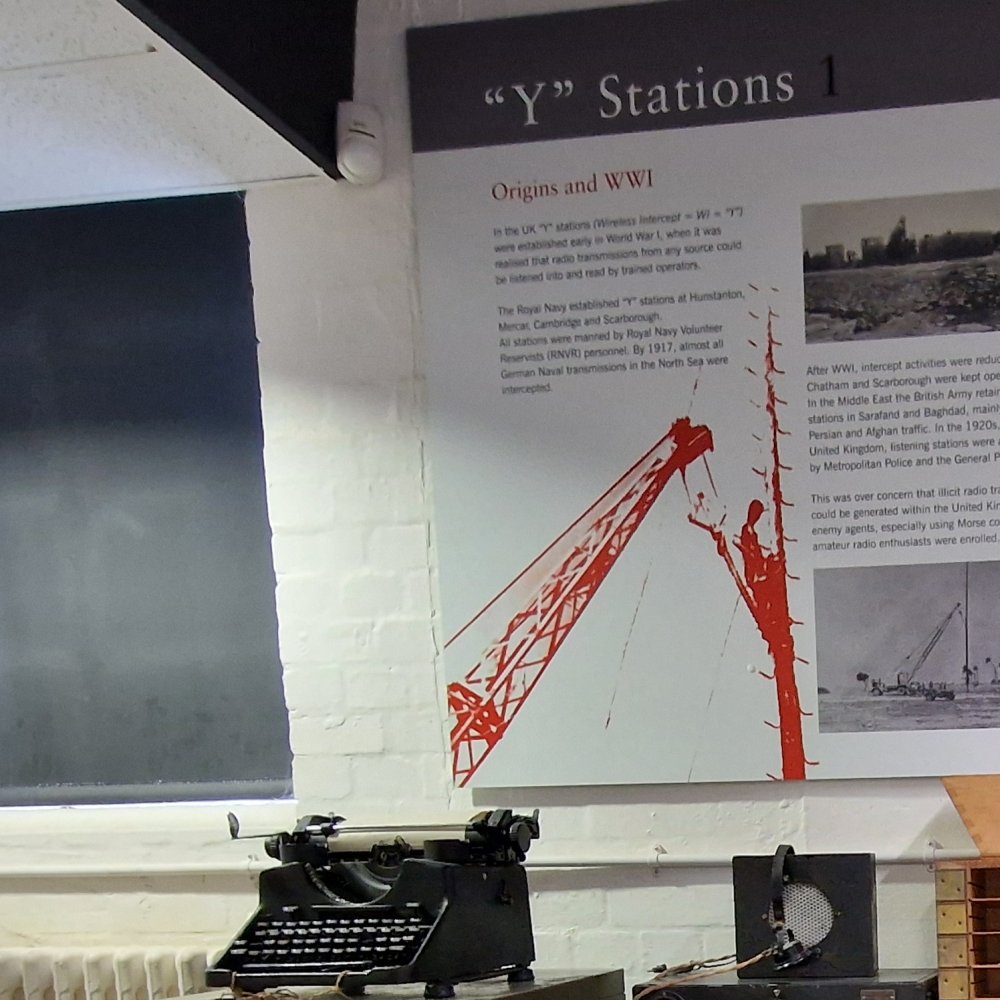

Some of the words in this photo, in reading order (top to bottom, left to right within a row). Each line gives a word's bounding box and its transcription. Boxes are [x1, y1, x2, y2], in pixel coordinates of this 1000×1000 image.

[484, 79, 574, 126] “Y”
[599, 66, 795, 119] Stations
[820, 53, 839, 97] 1
[491, 179, 559, 203] Origins
[564, 173, 598, 195] and
[604, 168, 653, 192] WWI
[493, 227, 502, 236] In
[505, 226, 519, 236] the
[522, 224, 536, 235] UK
[556, 221, 591, 232] stations
[593, 217, 636, 229] (Wireless
[639, 212, 681, 225] Intercept
[494, 244, 515, 252] were
[518, 240, 567, 251] established
[570, 239, 592, 248] early
[606, 232, 633, 243] World
[636, 231, 654, 241] War
[665, 228, 691, 239] when
[694, 227, 700, 237] it
[703, 226, 722, 236] was
[532, 256, 549, 265] that
[552, 255, 575, 264] radio
[577, 250, 638, 262] transmissions
[641, 247, 662, 256] from
[665, 247, 681, 256] any
[684, 244, 714, 253] source
[717, 240, 742, 251] could
[546, 270, 563, 281] into
[566, 269, 583, 279] and
[585, 267, 605, 278] read
[608, 266, 618, 277] by
[621, 264, 653, 275] trained
[499, 306, 514, 316] The
[517, 304, 541, 315] Royal
[544, 302, 566, 313] Navy
[569, 299, 620, 311] established
[640, 295, 675, 306] stations
[678, 294, 687, 304] at
[689, 289, 745, 301] Hunstanton,
[534, 318, 581, 330] Cambridge
[584, 316, 601, 326] and
[500, 337, 511, 347] All
[514, 336, 548, 346] stations
[551, 335, 572, 344] were
[575, 331, 610, 342] manned
[613, 330, 624, 341] by
[627, 328, 652, 339] Royal
[655, 326, 677, 337] Navy
[680, 324, 723, 335] Volunteer
[547, 348, 581, 360] (RNVR)
[633, 344, 645, 356] By
[648, 342, 677, 353] 1917,
[679, 340, 710, 351] almost
[713, 339, 724, 349] all
[501, 369, 536, 379] German
[538, 366, 564, 376] Naval
[566, 363, 627, 375] transmissions
[630, 361, 638, 370] in
[641, 360, 656, 370] the
[658, 357, 684, 368] North
[687, 356, 704, 367] Sea
[706, 355, 729, 365] were
[806, 365, 829, 376] After
[832, 363, 858, 374] WWI,
[861, 361, 902, 372] intercept
[905, 357, 947, 369] activities
[950, 358, 973, 367] were
[806, 380, 849, 392] Chatham
[852, 379, 870, 389] and
[872, 375, 932, 388] Scarborough
[934, 374, 957, 384] were
[960, 372, 981, 383] kept
[808, 398, 817, 407] In
[820, 396, 835, 407] the
[837, 395, 870, 406] Middle
[872, 393, 892, 404] East
[895, 392, 911, 402] the
[914, 390, 945, 402] British
[947, 388, 972, 400] Army
[808, 413, 844, 424] stations
[847, 411, 856, 421] in
[858, 410, 900, 421] Sarafand
[902, 408, 921, 418] and
[924, 404, 969, 418] Baghdad,
[809, 430, 843, 440] Persian
[845, 428, 863, 438] and
[866, 426, 899, 439] Afghan
[901, 423, 931, 435] traffic.
[935, 422, 944, 432] In
[947, 421, 962, 432] the
[967, 419, 1000, 431] 1920s,
[809, 445, 840, 456] United
[843, 443, 888, 456] Kingdom,
[891, 440, 930, 452] listening
[932, 438, 969, 450] stations
[972, 437, 995, 447] were
[810, 463, 821, 474] by
[824, 458, 882, 471] Metropolitan
[885, 457, 913, 468] Police
[916, 456, 933, 466] and
[936, 454, 952, 465] the
[954, 451, 991, 464] General
[811, 493, 831, 504] This
[833, 493, 852, 502] was
[854, 492, 874, 502] over
[877, 489, 914, 501] concern
[916, 487, 935, 499] that
[938, 486, 960, 497] illicit
[964, 485, 988, 496] radio
[811, 508, 837, 519] could
[840, 509, 851, 518] be
[853, 505, 899, 520] generated
[901, 504, 931, 515] within
[933, 503, 949, 513] the
[951, 501, 983, 513] United
[811, 526, 842, 536] enemy
[845, 522, 878, 535] agents,
[881, 520, 926, 533] especially
[929, 518, 955, 531] using
[957, 518, 986, 529] Morse
[812, 540, 850, 551] amateur
[853, 538, 877, 549] radio
[879, 536, 932, 548] enthusiasts
[934, 536, 957, 545] were
[960, 533, 1000, 545] enrolled.
